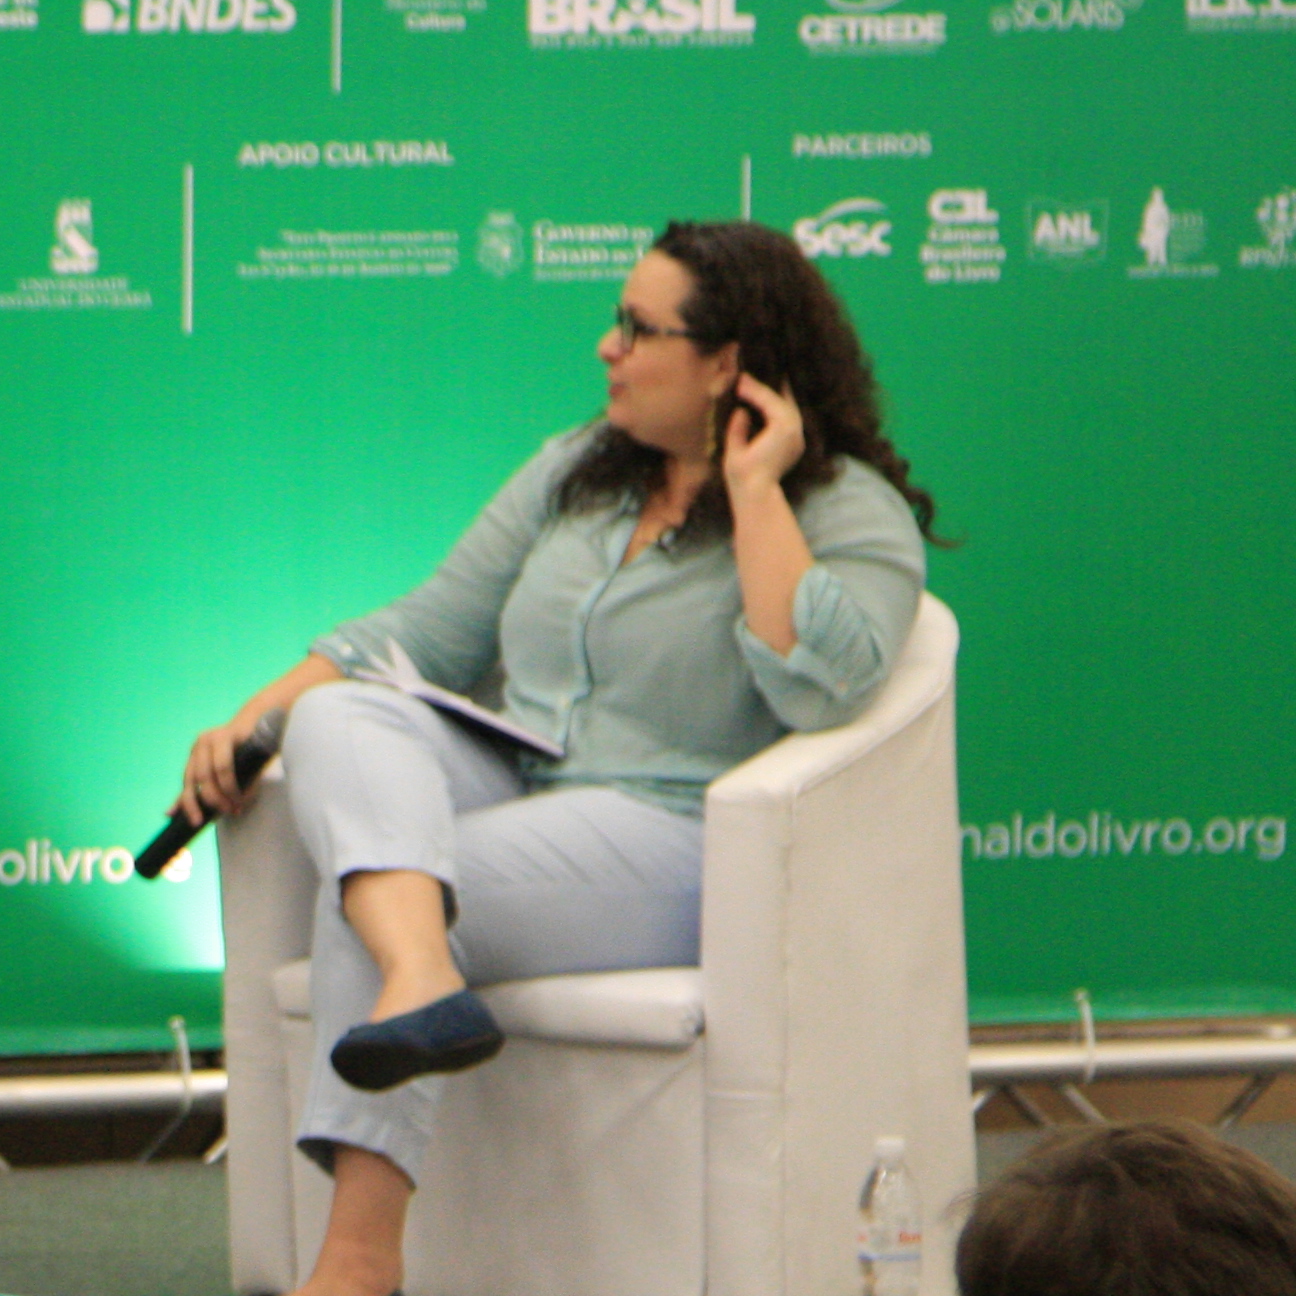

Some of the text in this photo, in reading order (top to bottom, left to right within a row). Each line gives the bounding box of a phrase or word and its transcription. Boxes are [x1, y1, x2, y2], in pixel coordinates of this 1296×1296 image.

[135, 0, 297, 33] BNDES
[528, 0, 756, 33] BRASIL
[798, 14, 947, 44] CETREDE
[238, 139, 455, 167] APOIO CULTURAL
[793, 131, 933, 158] PARCEIROS
[1034, 211, 1100, 247] ANL
